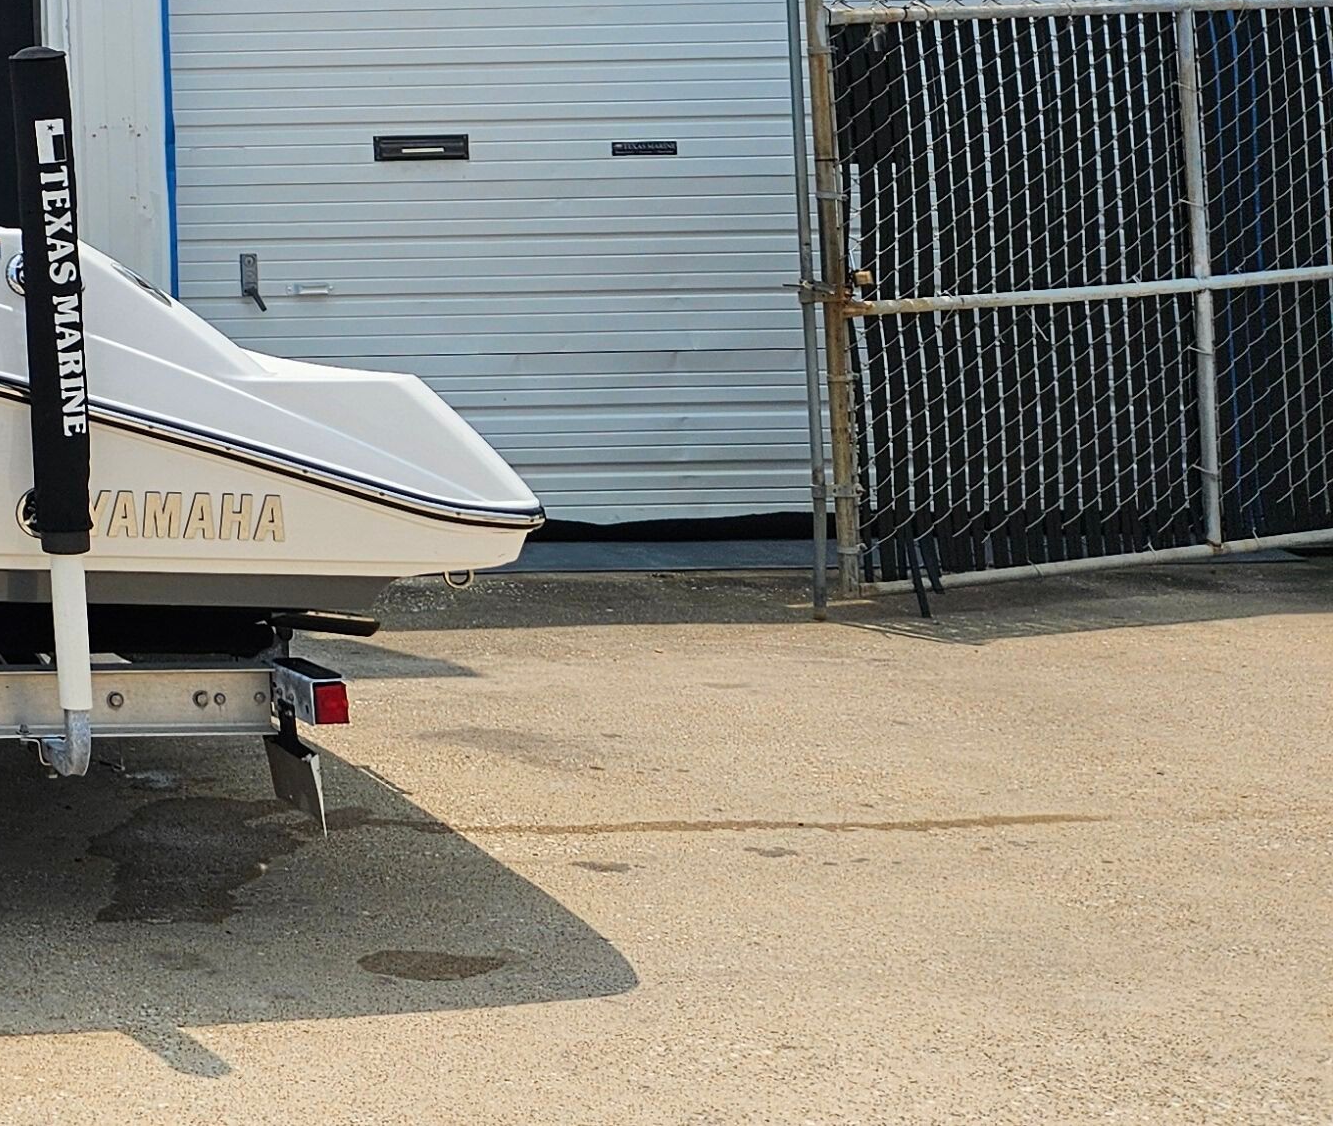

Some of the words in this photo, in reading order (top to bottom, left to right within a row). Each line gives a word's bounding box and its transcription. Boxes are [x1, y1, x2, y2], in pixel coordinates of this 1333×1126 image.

[39, 165, 77, 285] TEXAS
[52, 292, 87, 437] MARINE
[89, 488, 285, 542] YAMAHA
